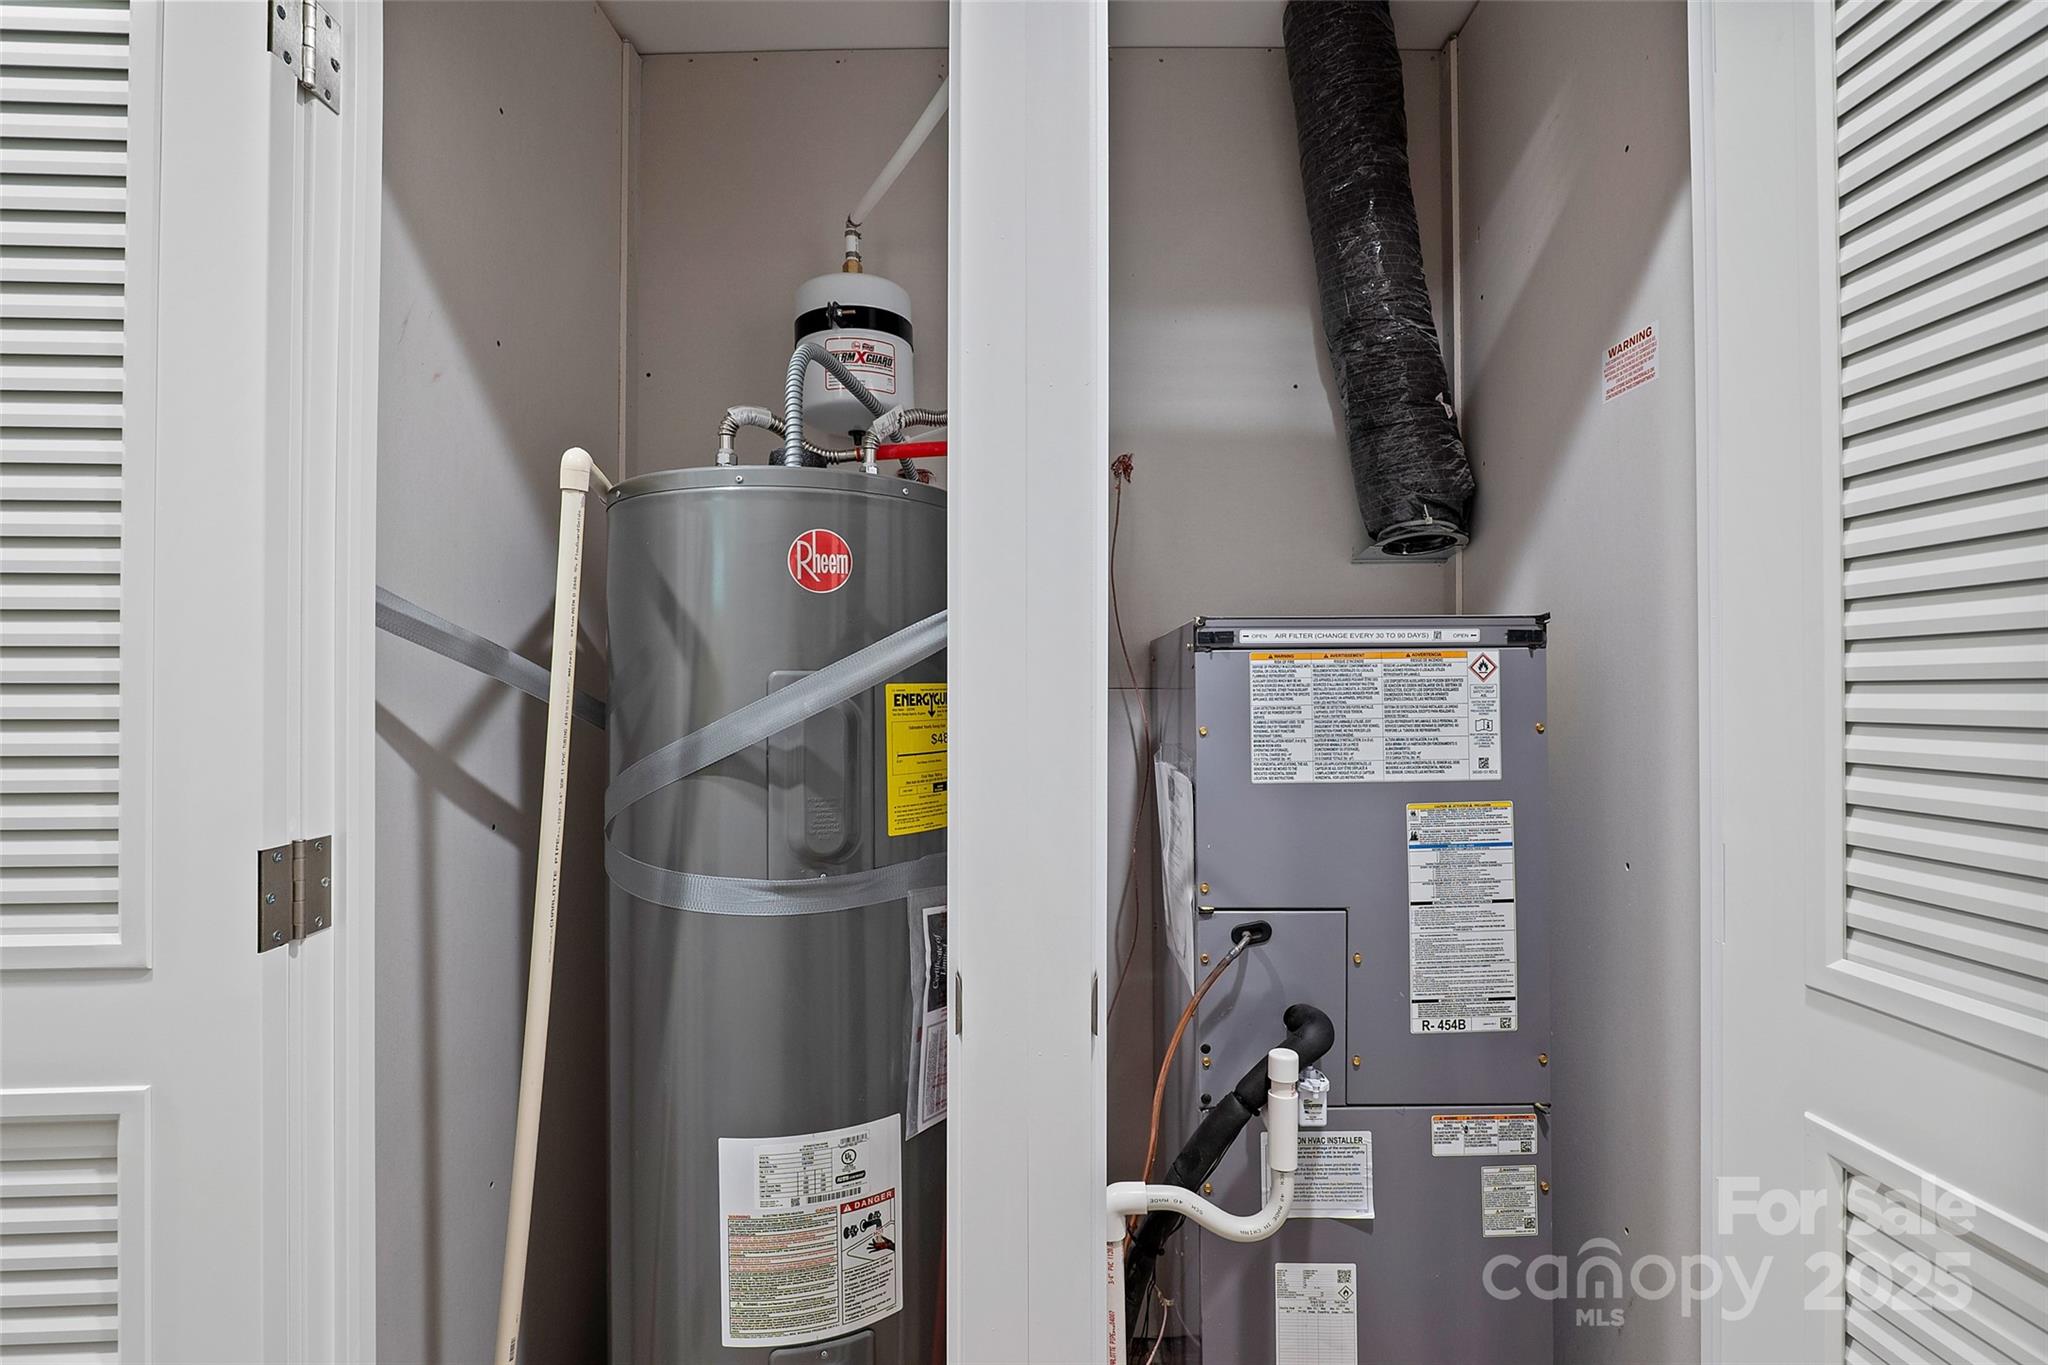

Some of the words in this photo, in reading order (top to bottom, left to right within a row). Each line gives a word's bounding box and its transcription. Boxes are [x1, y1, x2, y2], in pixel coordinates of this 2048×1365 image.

[1608, 326, 1652, 359] WARNING
[797, 530, 849, 583] Rheem
[932, 933, 943, 944] of
[932, 945, 943, 990] Certificate
[1422, 1020, 1435, 1031] R-
[1437, 1019, 1466, 1030] 454B
[1326, 1136, 1363, 1144] INSTALLER
[854, 1190, 893, 1210] DANGER
